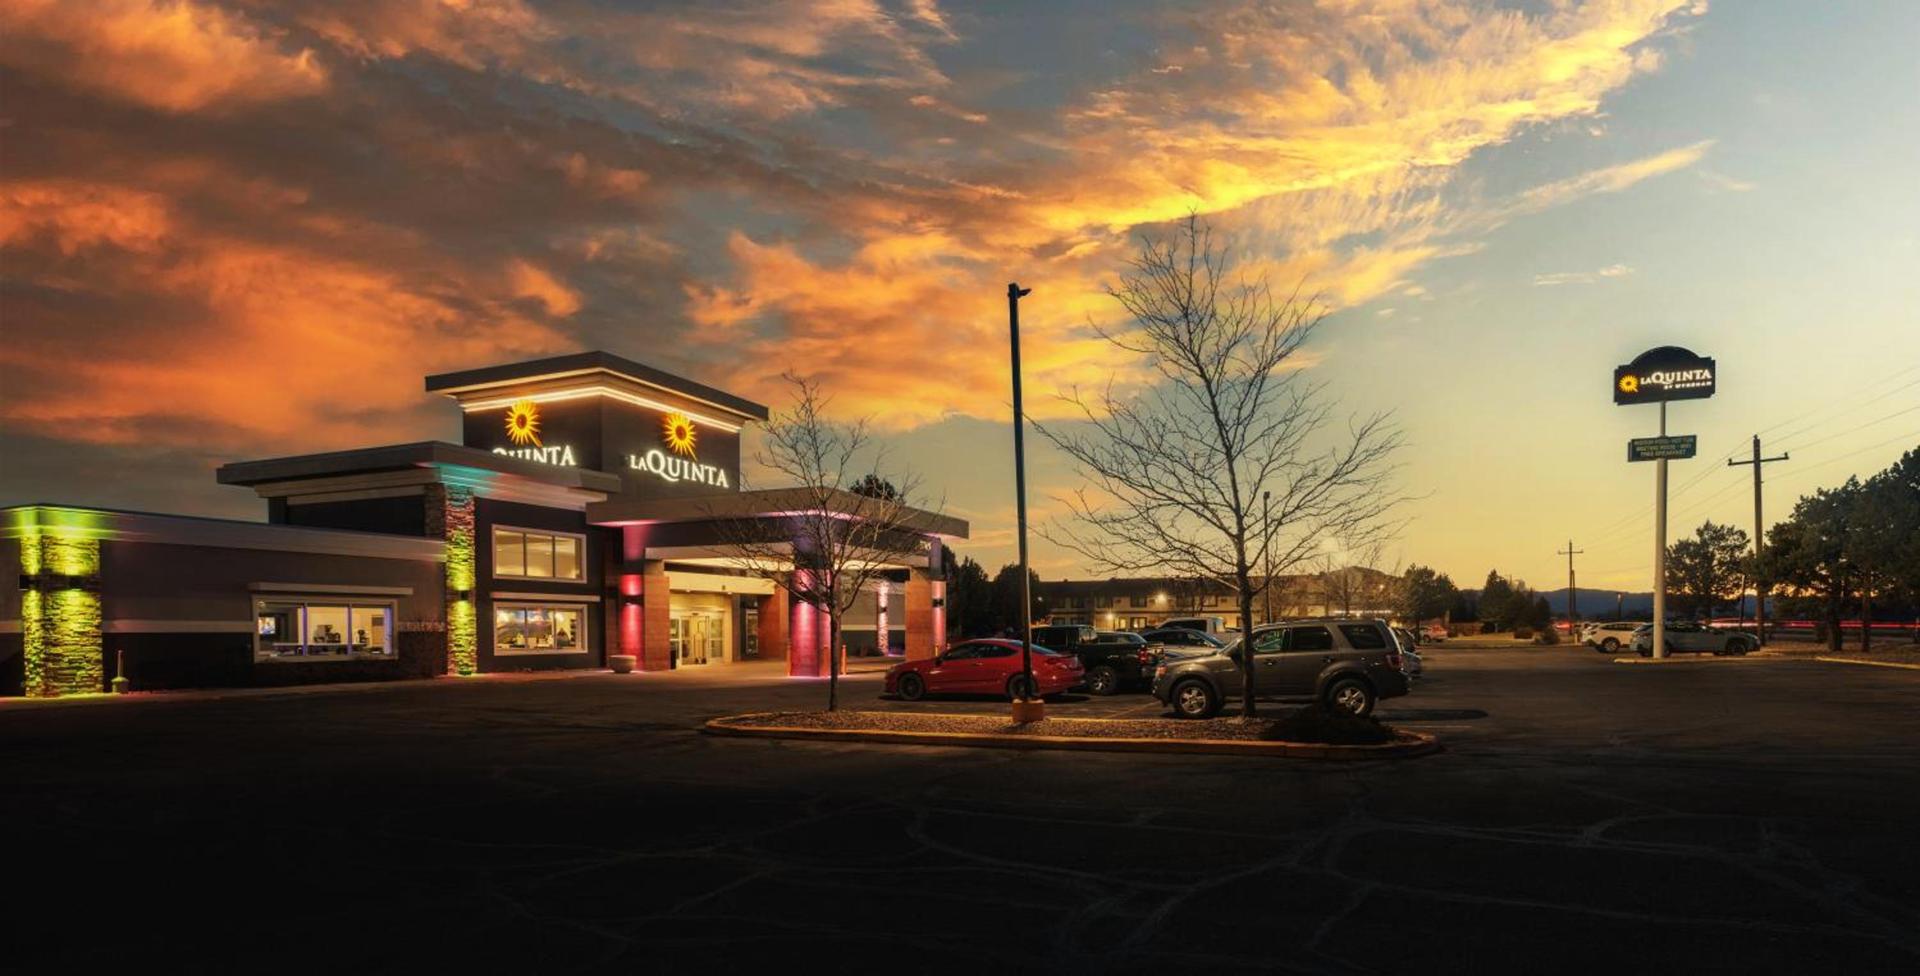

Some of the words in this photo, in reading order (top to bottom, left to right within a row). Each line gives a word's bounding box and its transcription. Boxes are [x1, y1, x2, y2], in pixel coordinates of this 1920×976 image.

[1640, 377, 1651, 385] LA
[1651, 369, 1712, 385] QUINTA
[492, 445, 577, 466] INTA
[629, 454, 648, 471] LA
[646, 449, 729, 488] QUINTA
